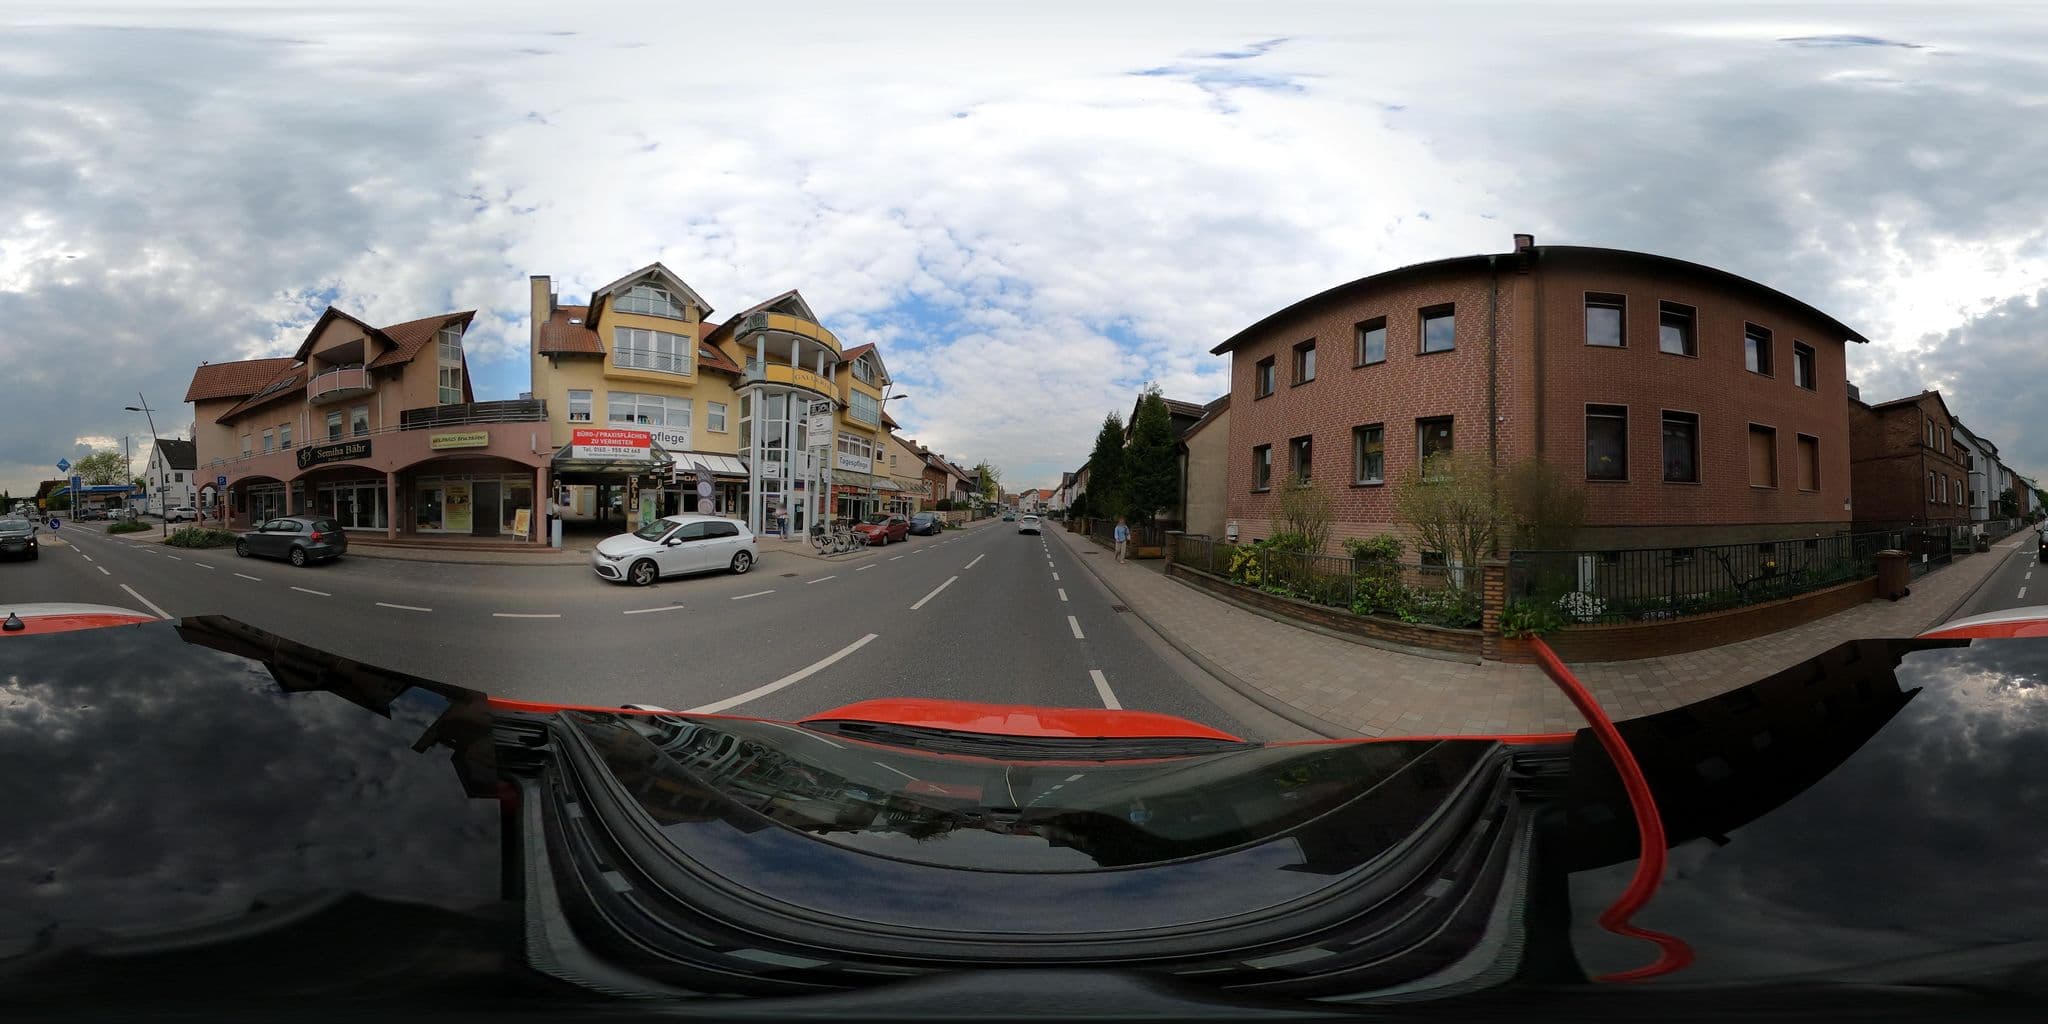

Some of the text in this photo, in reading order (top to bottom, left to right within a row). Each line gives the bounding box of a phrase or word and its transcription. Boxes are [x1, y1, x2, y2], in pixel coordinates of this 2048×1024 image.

[651, 432, 684, 444] pflege
[317, 444, 366, 458] Semiha Bähr
[840, 457, 867, 469] Tagespflege
